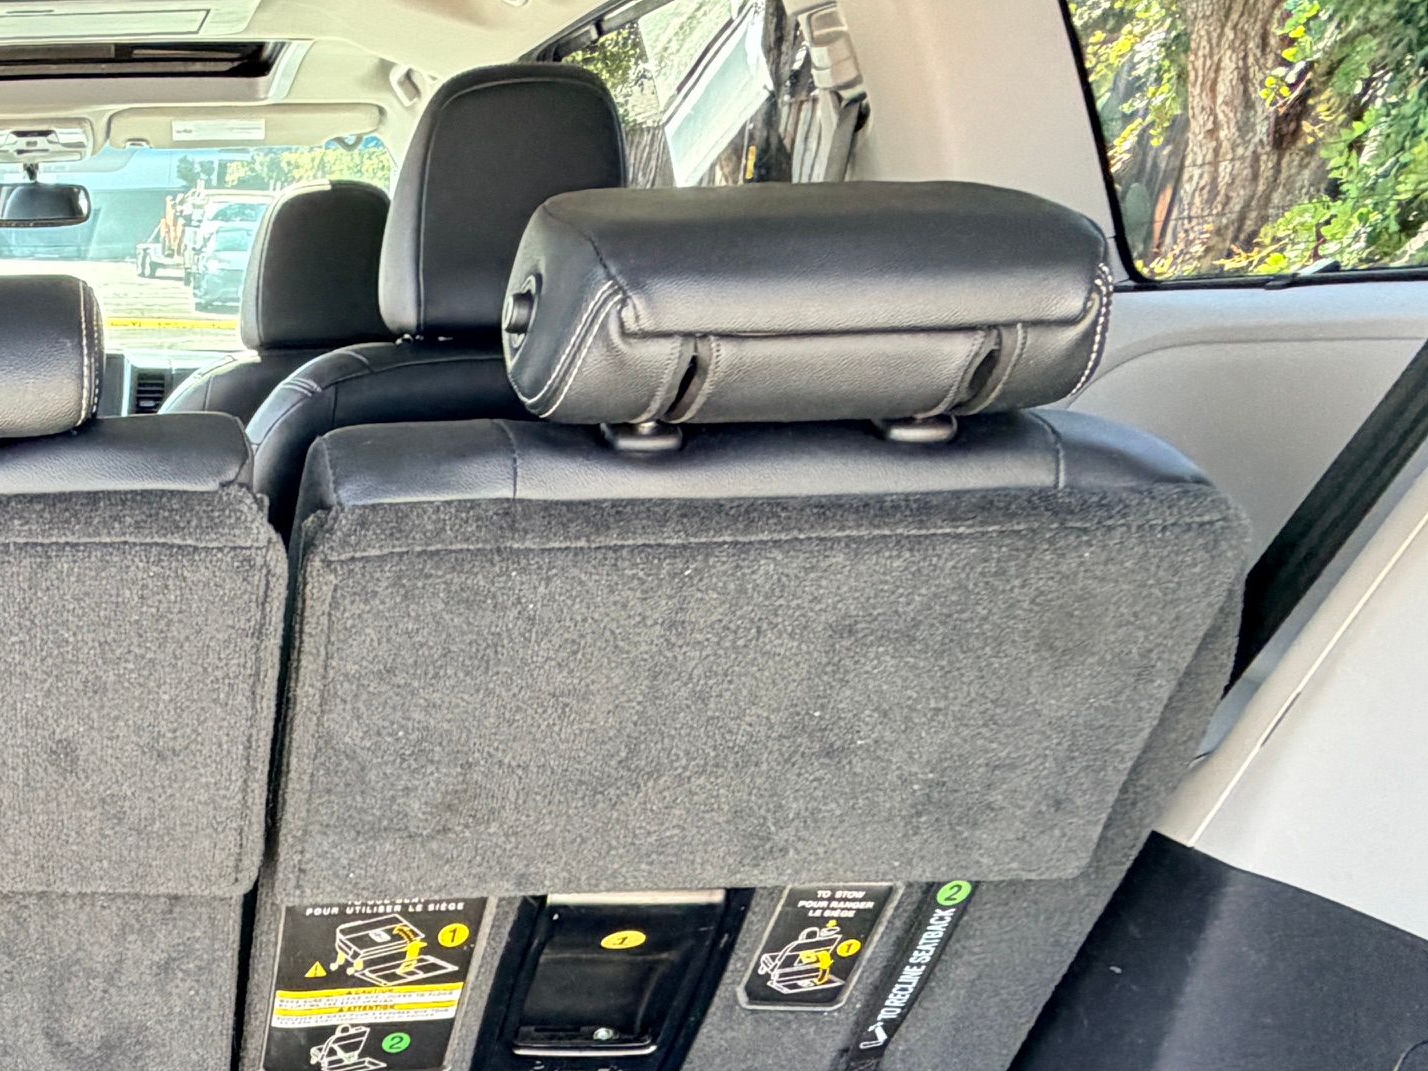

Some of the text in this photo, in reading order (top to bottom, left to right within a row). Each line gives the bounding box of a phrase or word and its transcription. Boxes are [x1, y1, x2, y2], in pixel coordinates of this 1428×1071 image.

[817, 890, 866, 899] TO STOW
[945, 884, 963, 901] 2
[797, 900, 829, 908] POUR
[305, 907, 339, 916] POUR
[346, 905, 402, 915] UTILISER
[408, 904, 422, 912] LE
[808, 909, 823, 917] LE
[877, 908, 956, 1020] TO RECLINE SEATBACK
